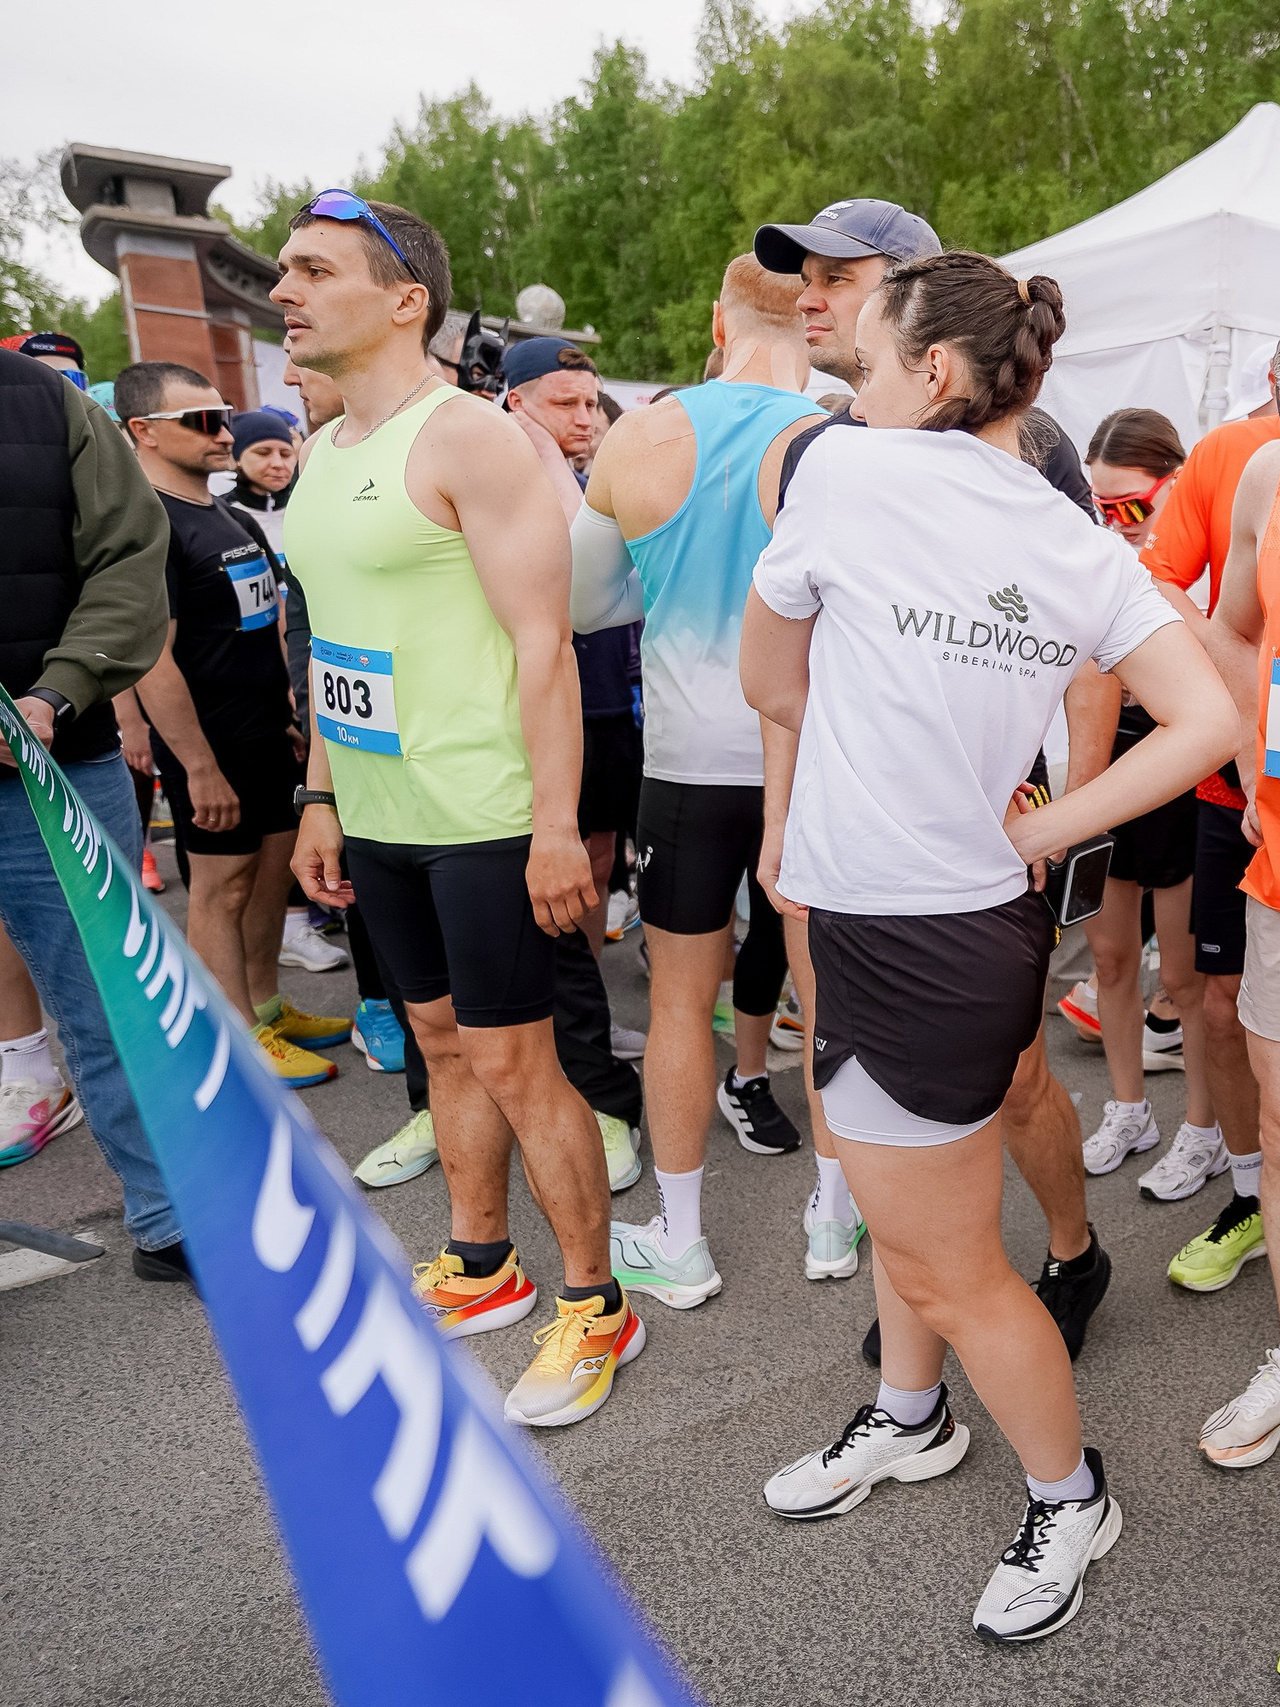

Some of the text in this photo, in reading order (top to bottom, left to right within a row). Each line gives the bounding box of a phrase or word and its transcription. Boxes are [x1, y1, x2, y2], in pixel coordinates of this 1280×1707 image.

[891, 604, 1078, 667] WILDWOOD
[942, 651, 1013, 674] SIBERIAN
[1018, 667, 1037, 679] SPA
[323, 671, 373, 719] 803
